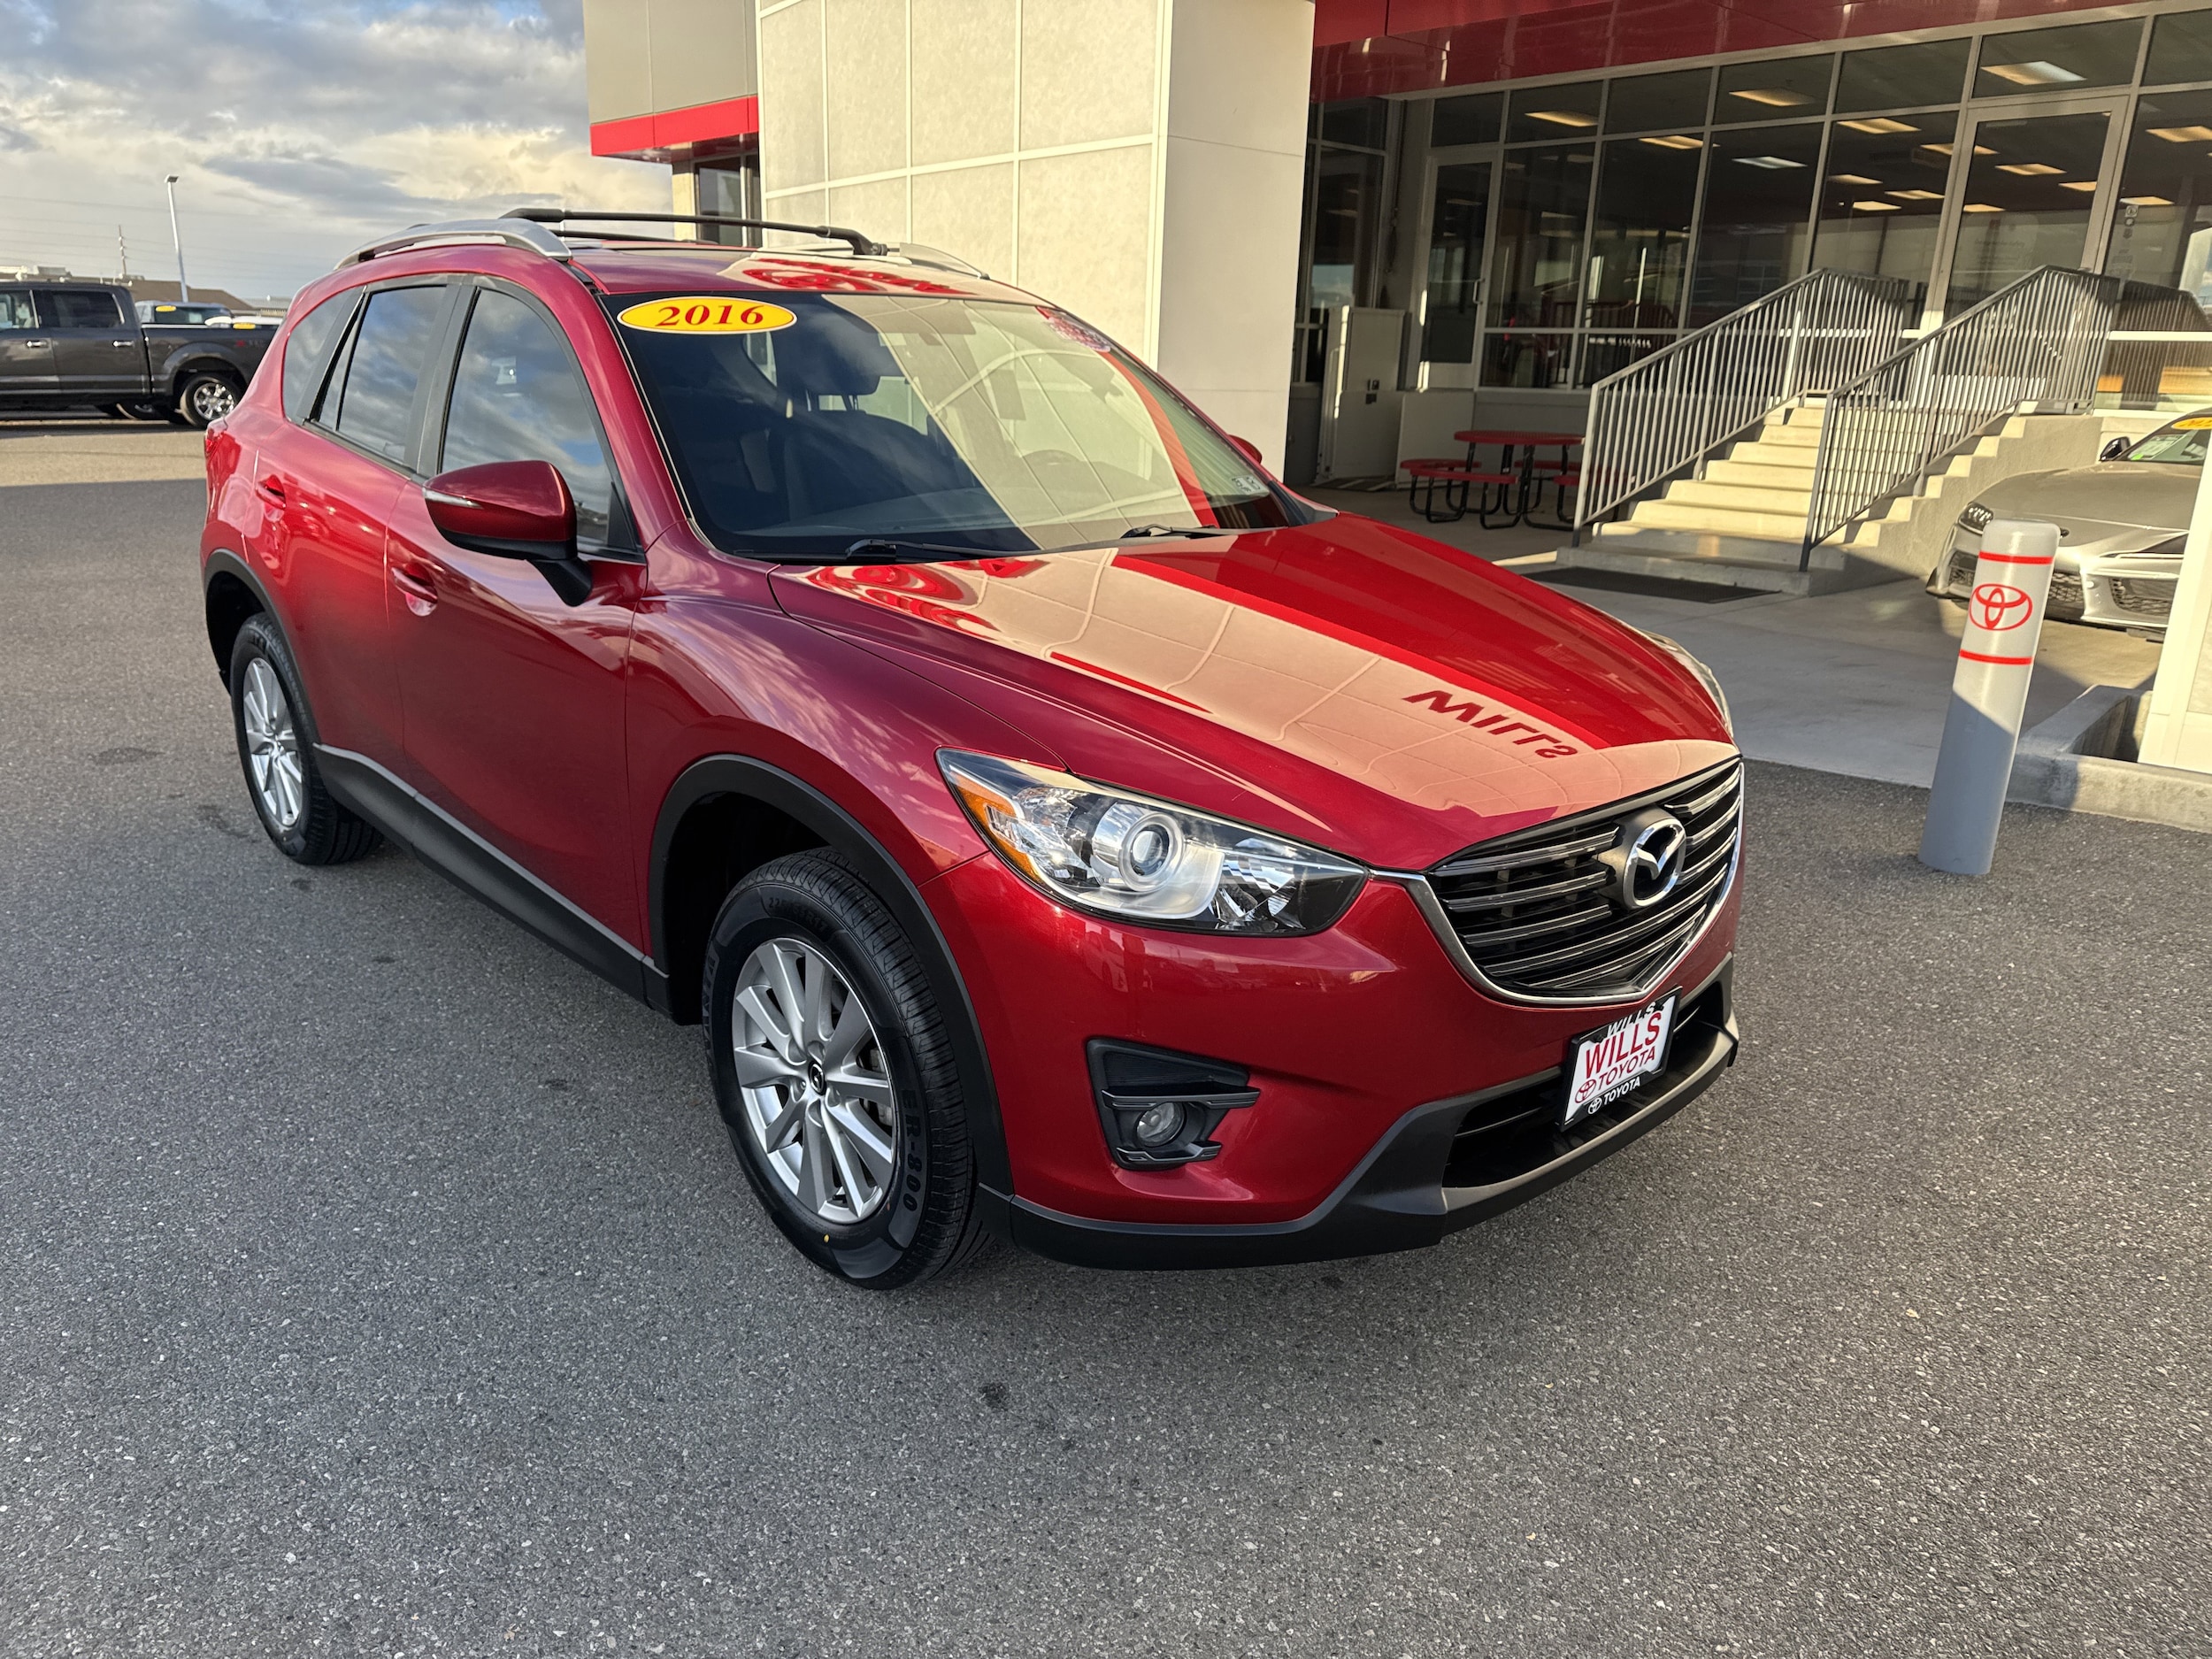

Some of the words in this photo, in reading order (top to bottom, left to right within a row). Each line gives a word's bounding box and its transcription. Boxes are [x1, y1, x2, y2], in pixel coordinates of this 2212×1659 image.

[655, 303, 764, 327] 2016
[1607, 1002, 1656, 1036] WILLS
[1586, 1011, 1662, 1079] WILLS
[1598, 1046, 1655, 1091] TOYOTA
[1603, 1076, 1640, 1105] TOYOTA
[901, 1089, 923, 1212] ER-800
